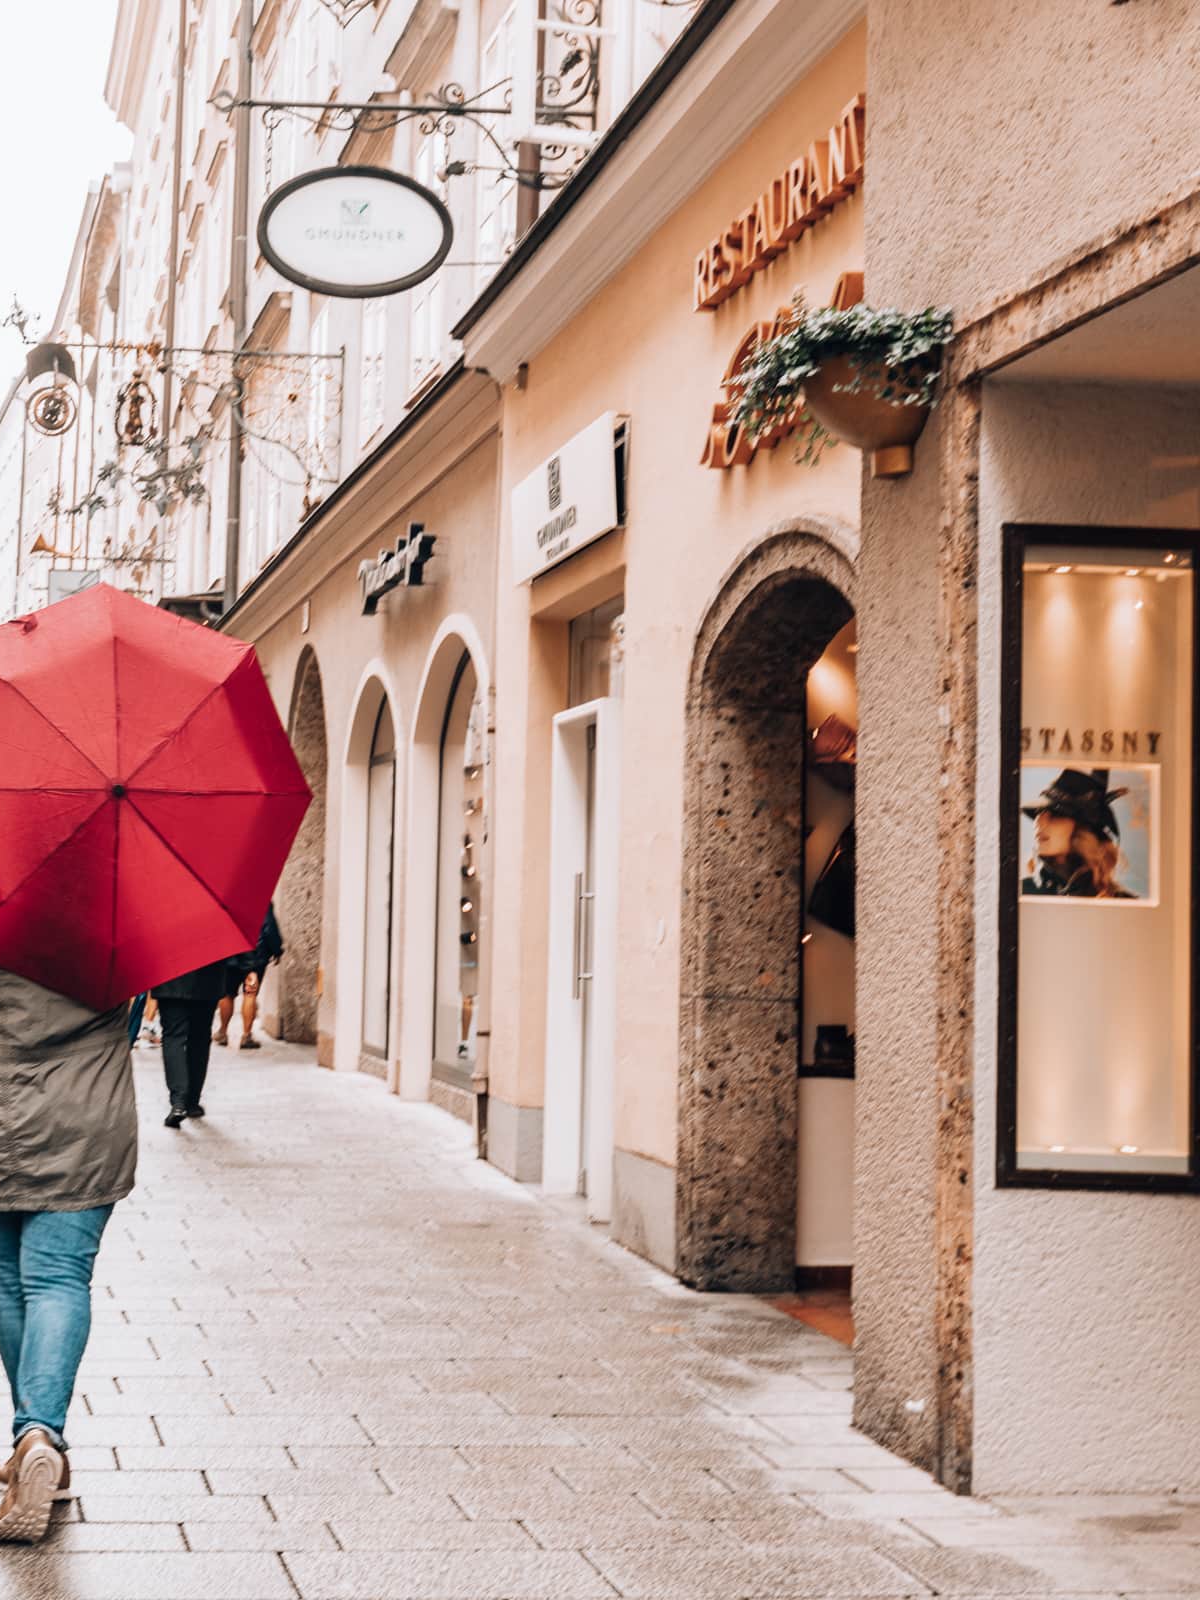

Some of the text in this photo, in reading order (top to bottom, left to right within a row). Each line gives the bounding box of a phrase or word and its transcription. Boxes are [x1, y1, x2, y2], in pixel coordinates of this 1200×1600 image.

[693, 92, 866, 312] RESTAURANT
[304, 228, 406, 241] GMUNDNER
[1021, 727, 1161, 754] STASSNY
